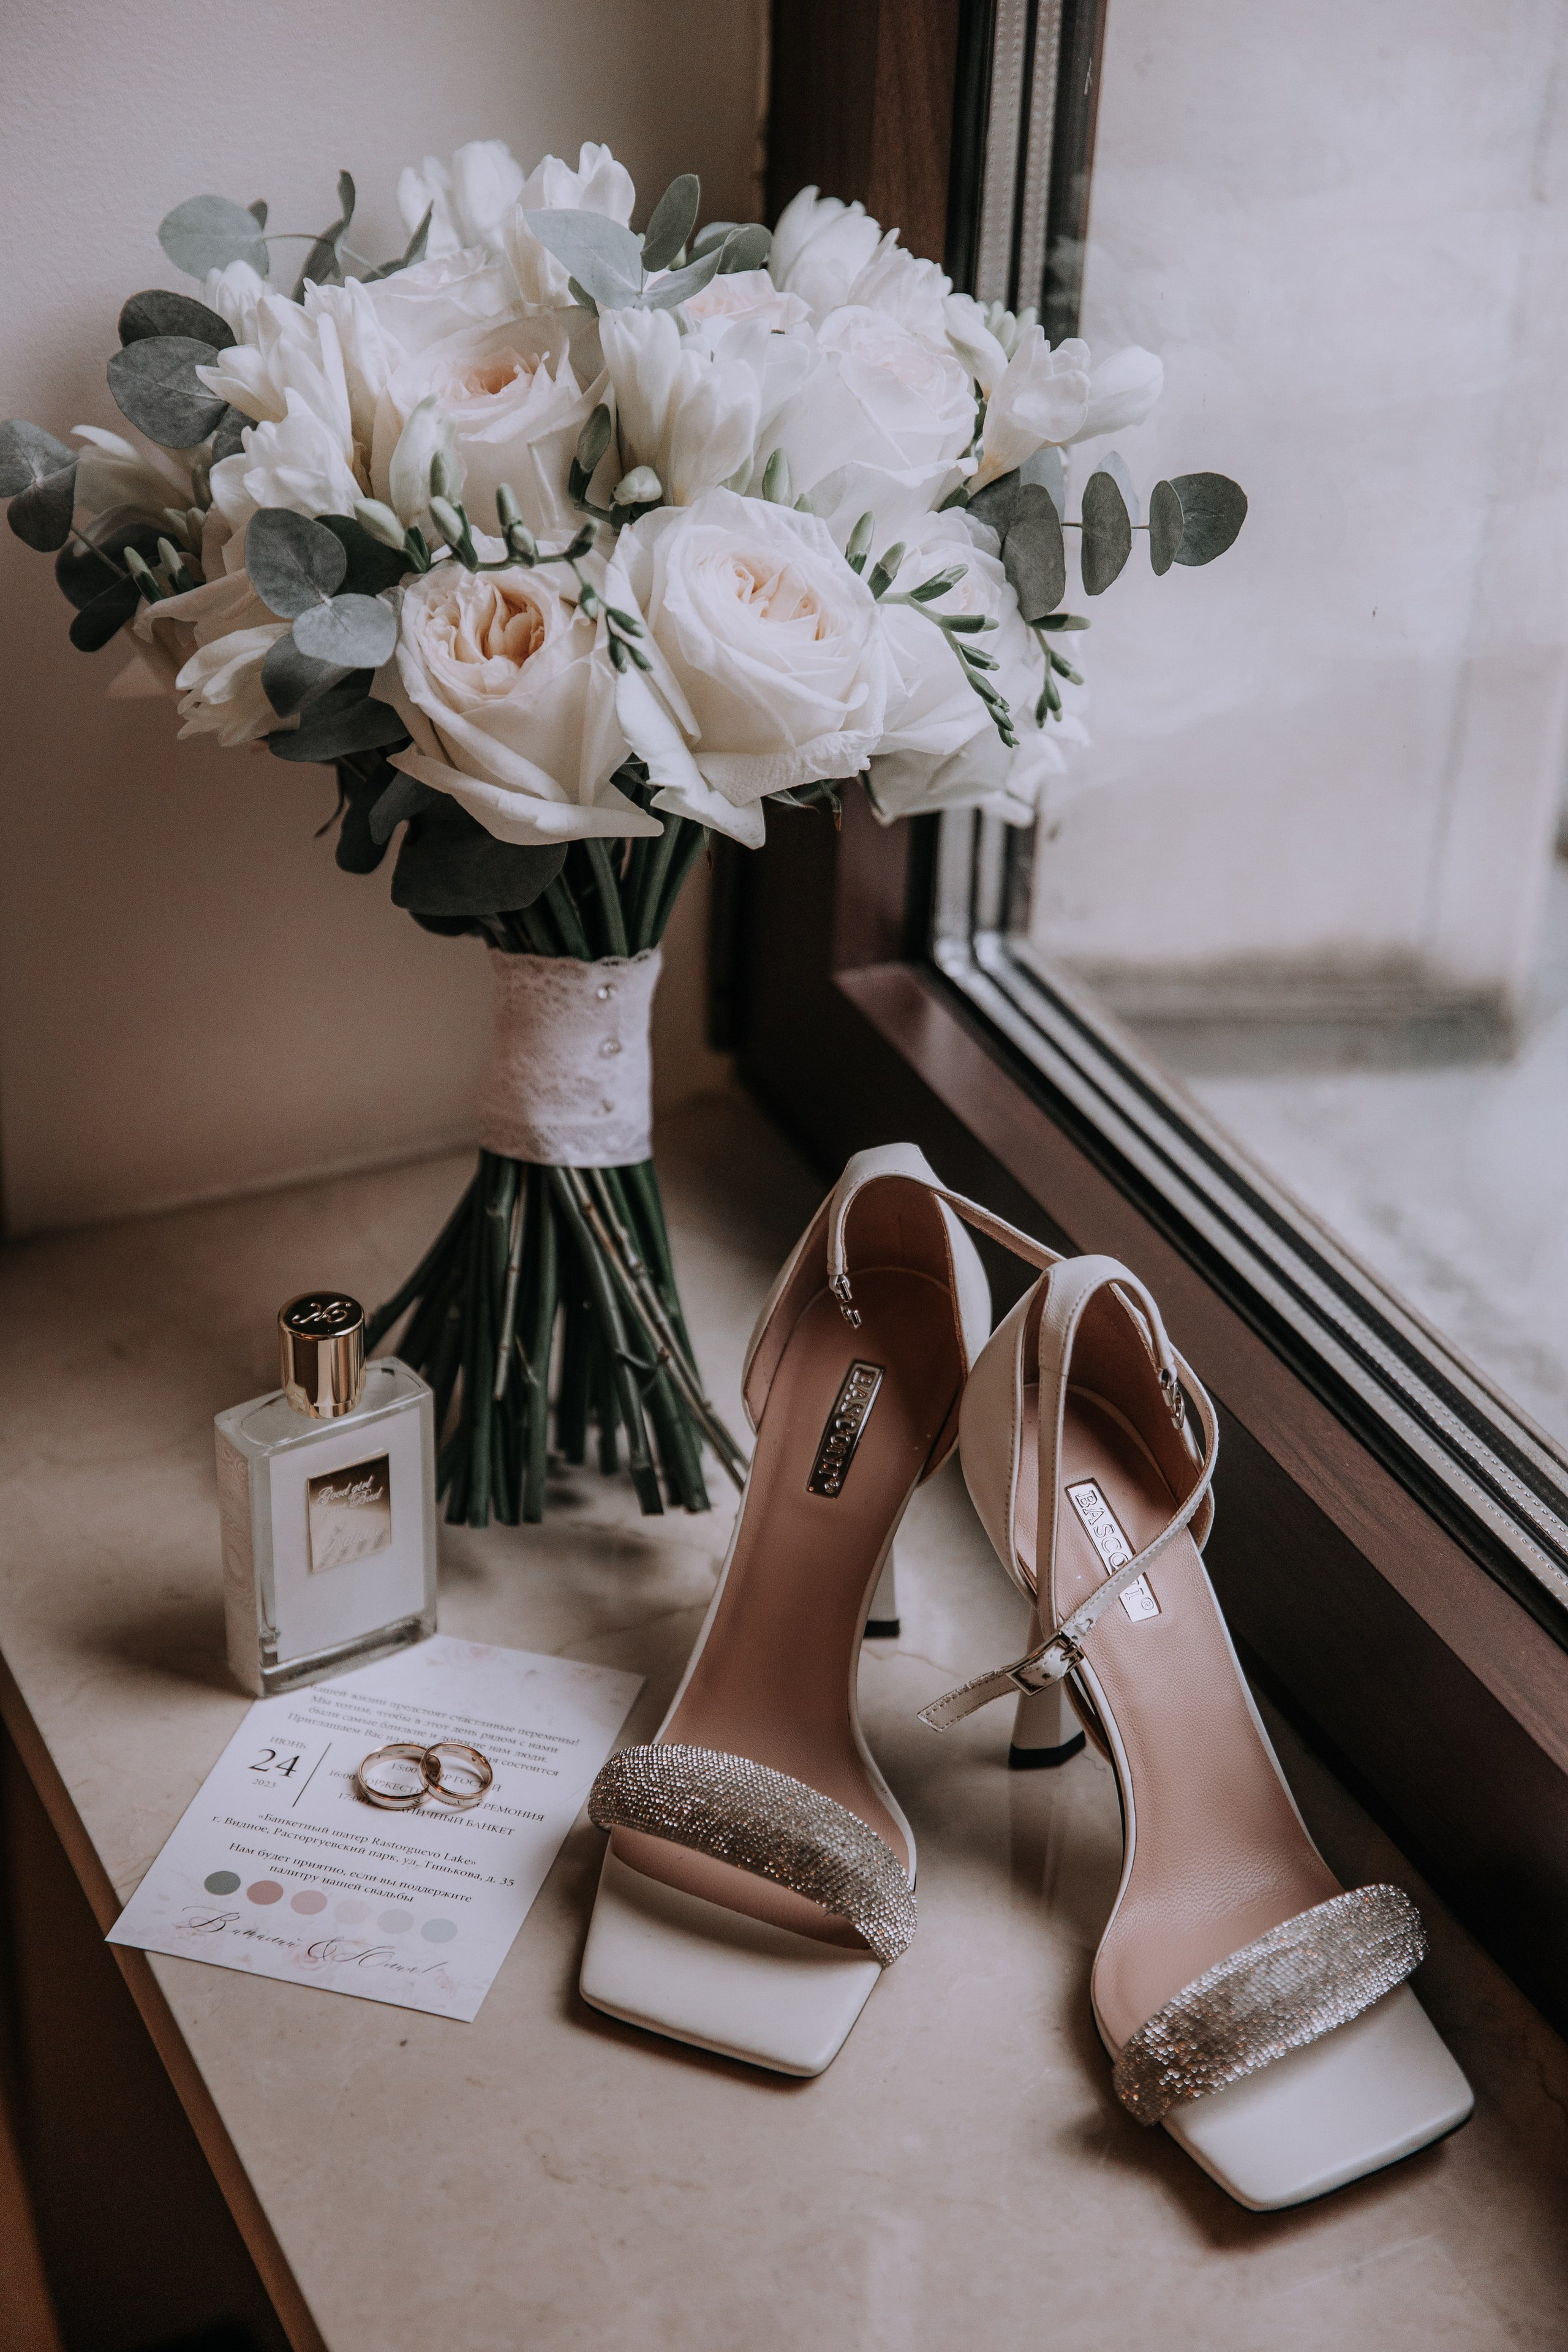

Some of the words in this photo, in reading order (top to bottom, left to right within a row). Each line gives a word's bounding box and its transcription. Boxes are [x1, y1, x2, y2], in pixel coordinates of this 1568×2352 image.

[270, 1736, 306, 1750] ИЮНЬ
[309, 1706, 339, 1719] были
[341, 1714, 378, 1727] самые
[380, 1721, 427, 1738] близкие
[488, 1746, 511, 1755] нам
[310, 1695, 332, 1706] Мы
[376, 1709, 412, 1722] чтобы
[423, 1721, 450, 1730] этот
[450, 1726, 477, 1736] день
[480, 1732, 516, 1745] рядом
[529, 1743, 559, 1754] нами
[350, 1694, 386, 1706] жизни
[389, 1702, 448, 1717] предстоят
[449, 1714, 515, 1733] счастливые
[518, 1728, 580, 1746] перемены!
[247, 1748, 300, 1778] 24
[287, 1713, 361, 1735] Приглашаем
[364, 1728, 384, 1740] Вас
[501, 1760, 559, 1777] состоится
[391, 1763, 418, 1774] 15:00
[252, 1778, 276, 1789] 2023
[329, 1770, 356, 1781] 16:00
[477, 1801, 545, 1822] ЕРЕМОНИЯ
[338, 1792, 365, 1804] 17:00
[466, 1819, 516, 1837] БАНКЕТ
[273, 1827, 366, 1855] Расторгуевский
[402, 1858, 419, 1867] ул.
[499, 1878, 515, 1887] 35
[332, 1830, 369, 1844] шатер
[372, 1837, 441, 1859] Rastorguevo
[228, 1842, 255, 1855] Нам
[257, 1849, 291, 1863] будет
[293, 1858, 347, 1877] приятно,
[349, 1870, 378, 1882] если
[380, 1877, 397, 1887] вы
[399, 1882, 472, 1903] поддержите
[268, 1865, 320, 1883] палитру
[322, 1877, 362, 1891] нашей
[364, 1887, 415, 1903] свадьбы
